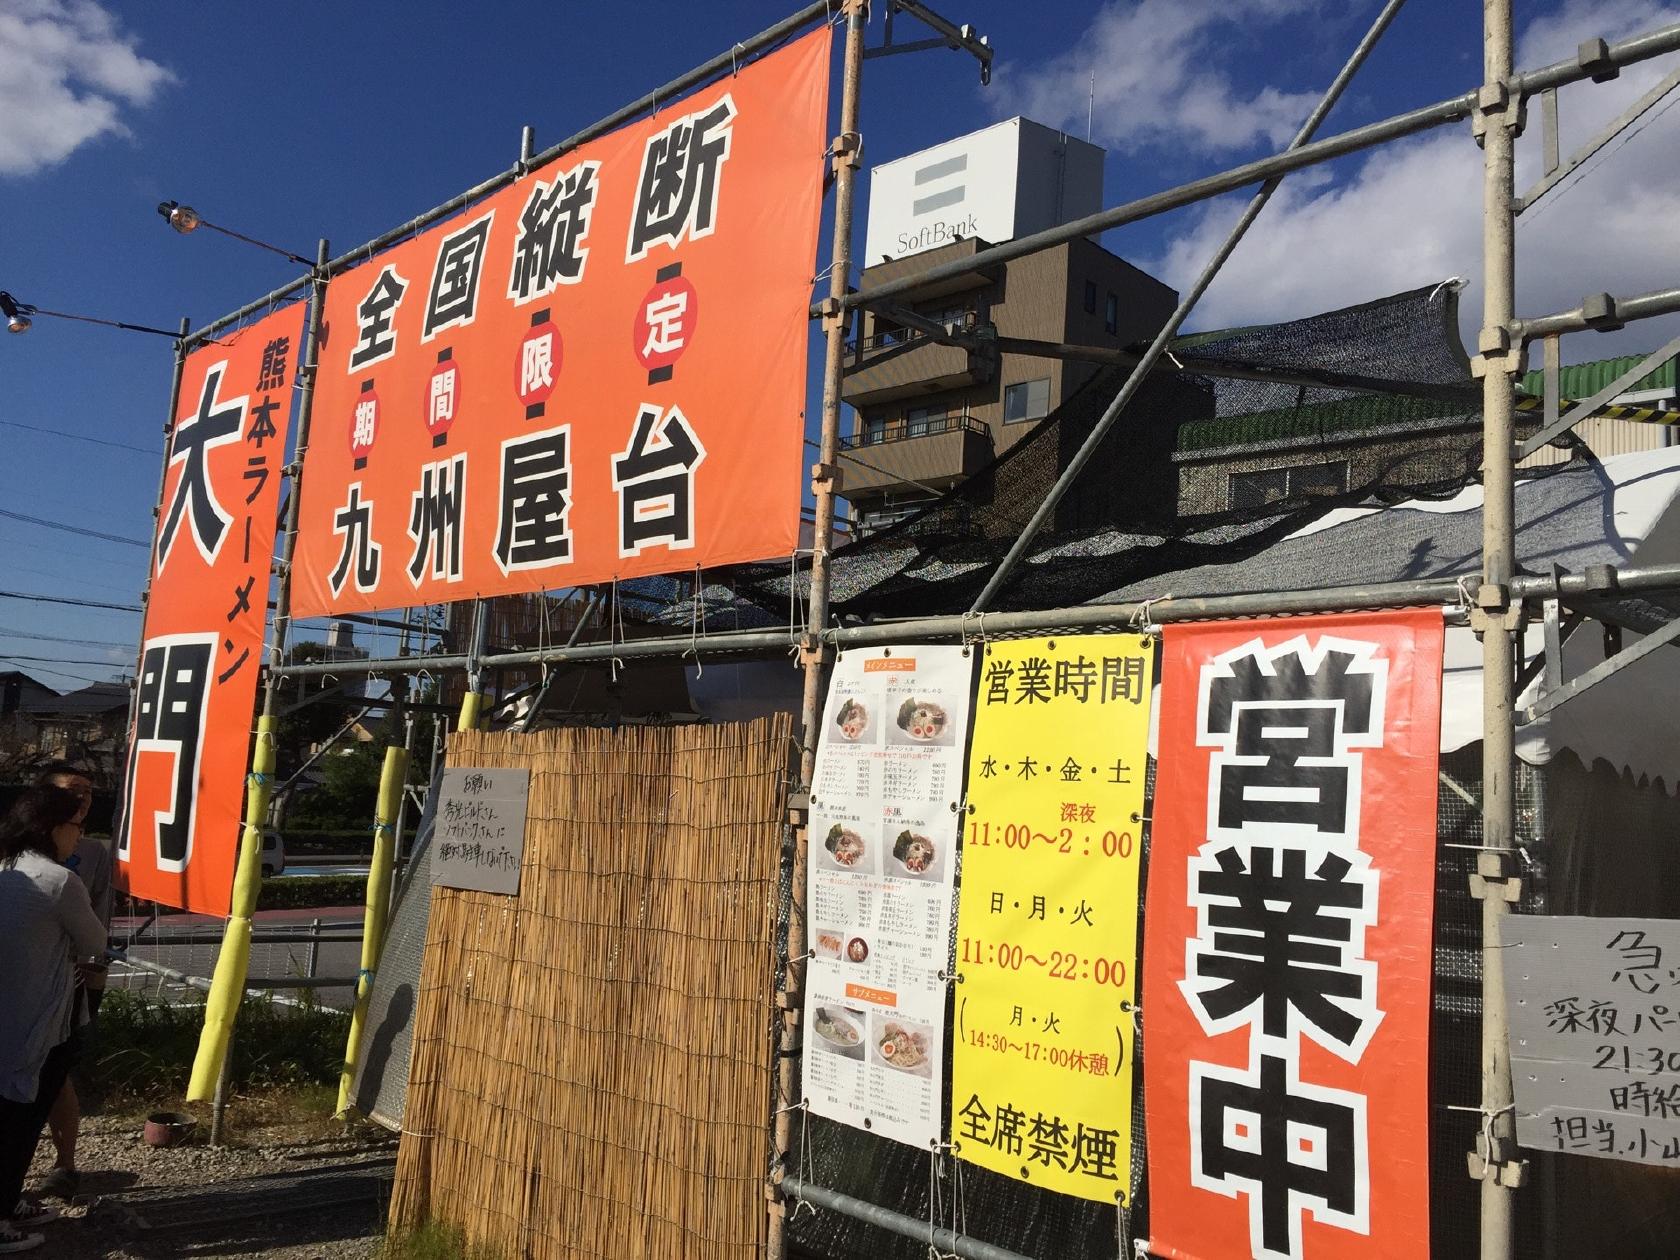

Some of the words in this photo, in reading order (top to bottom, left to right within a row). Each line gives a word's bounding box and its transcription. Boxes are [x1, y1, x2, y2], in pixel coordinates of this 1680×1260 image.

[348, 92, 738, 375] 全国縦断
[897, 213, 978, 254] SoftBank
[219, 338, 290, 686] 熊本ラーメン
[329, 404, 706, 600] 九州屋台
[116, 359, 249, 873] 大門
[984, 655, 1146, 706] 営業時間
[464, 773, 492, 795] お願い
[1060, 802, 1096, 824] 深夜
[1177, 634, 1389, 1260] 営業中
[1606, 931, 1680, 995] 急
[1543, 996, 1680, 1036] 深夜パー
[958, 1094, 1121, 1181] 全席禁煙
